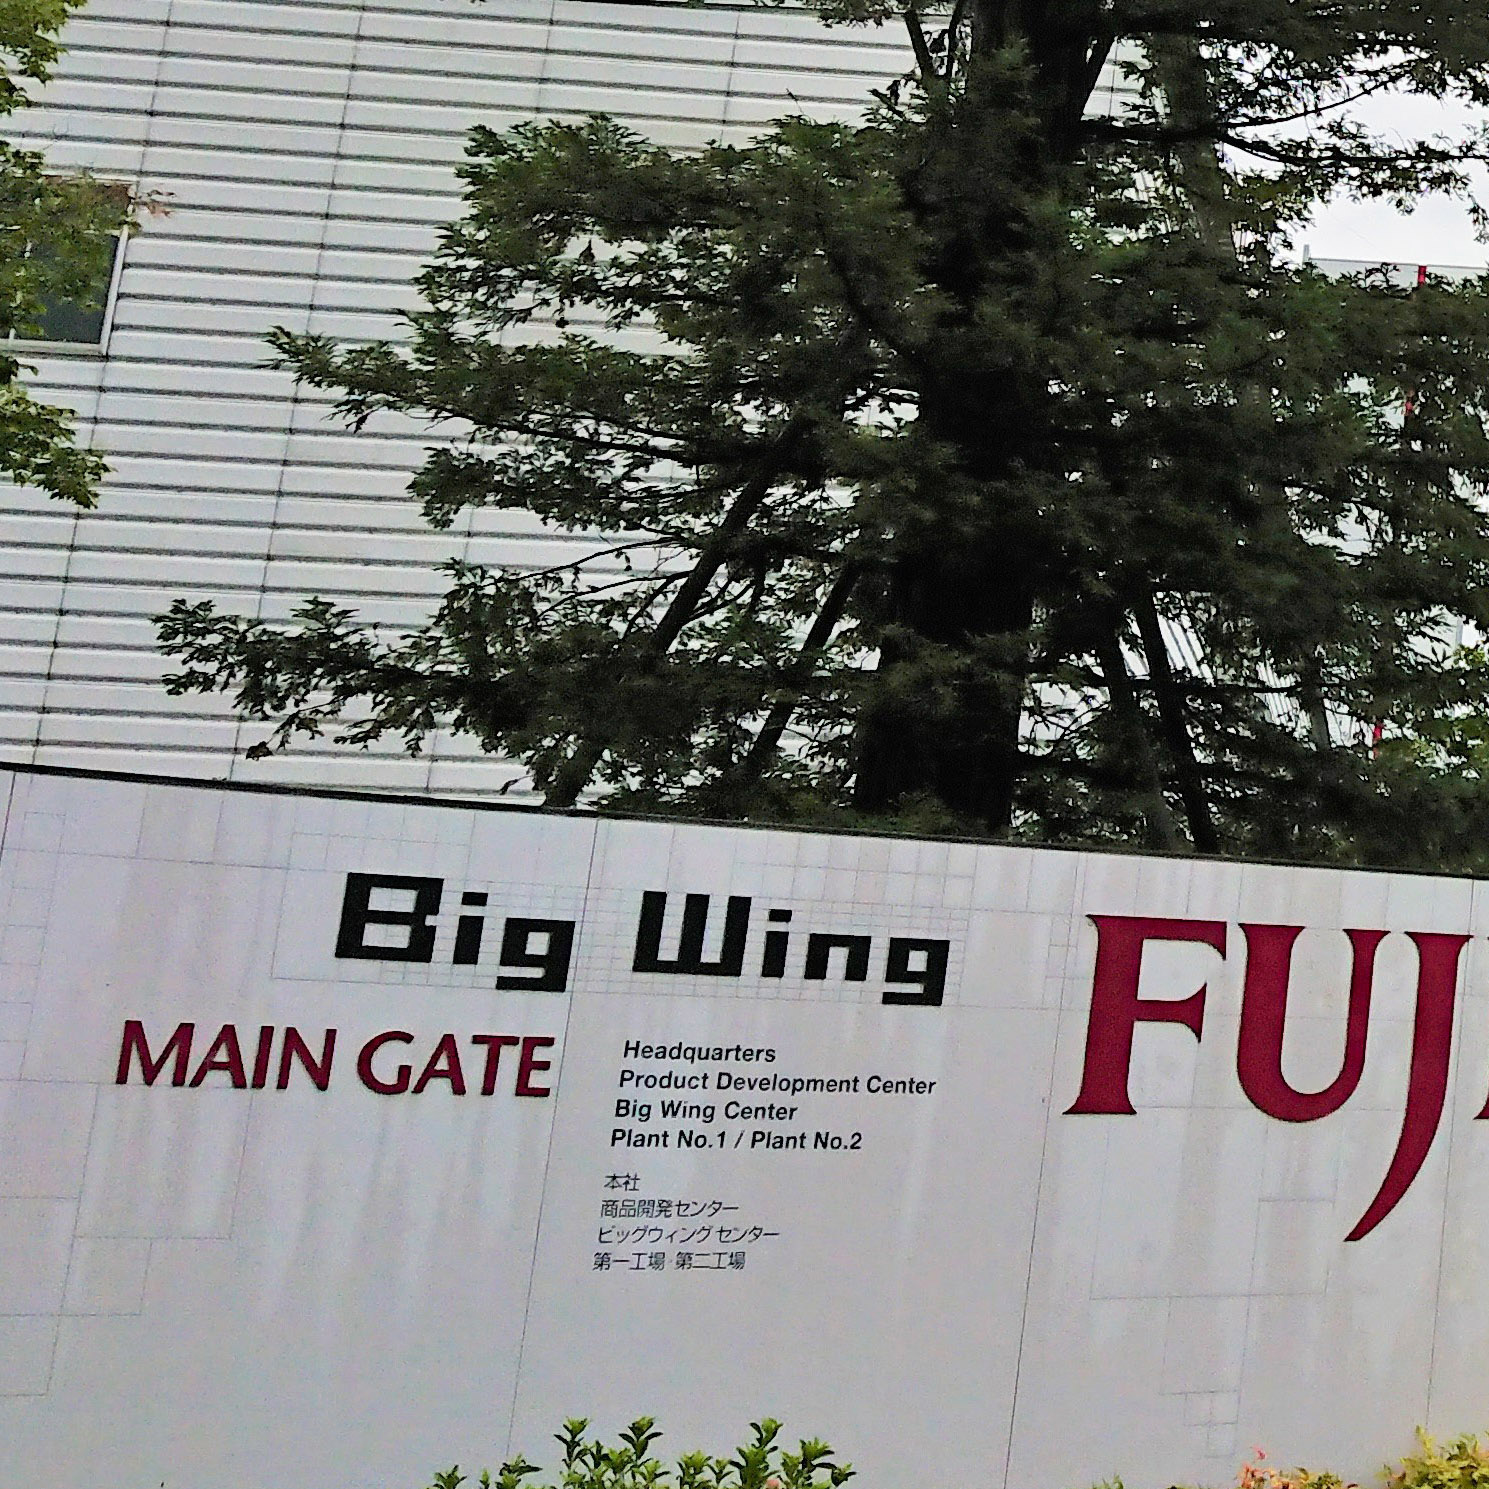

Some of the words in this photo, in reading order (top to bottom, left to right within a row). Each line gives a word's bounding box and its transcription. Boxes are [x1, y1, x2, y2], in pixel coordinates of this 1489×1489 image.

[334, 872, 576, 993] Big
[632, 891, 950, 1006] Wing
[115, 1020, 337, 1091] MAIN
[357, 1031, 555, 1098] GATE
[623, 1040, 776, 1064] Headquarters
[619, 1070, 709, 1090] Product
[716, 1072, 860, 1096] Development
[866, 1075, 937, 1095] Center
[614, 1099, 652, 1122] Big
[660, 1100, 716, 1123] Wing
[724, 1101, 799, 1121] Center
[610, 1129, 669, 1148] Plant
[677, 1130, 726, 1149] No.1
[751, 1130, 807, 1149] Plant
[813, 1131, 863, 1150] No.2
[604, 1173, 640, 1191] 本社
[601, 1199, 740, 1218] 商品開発センター
